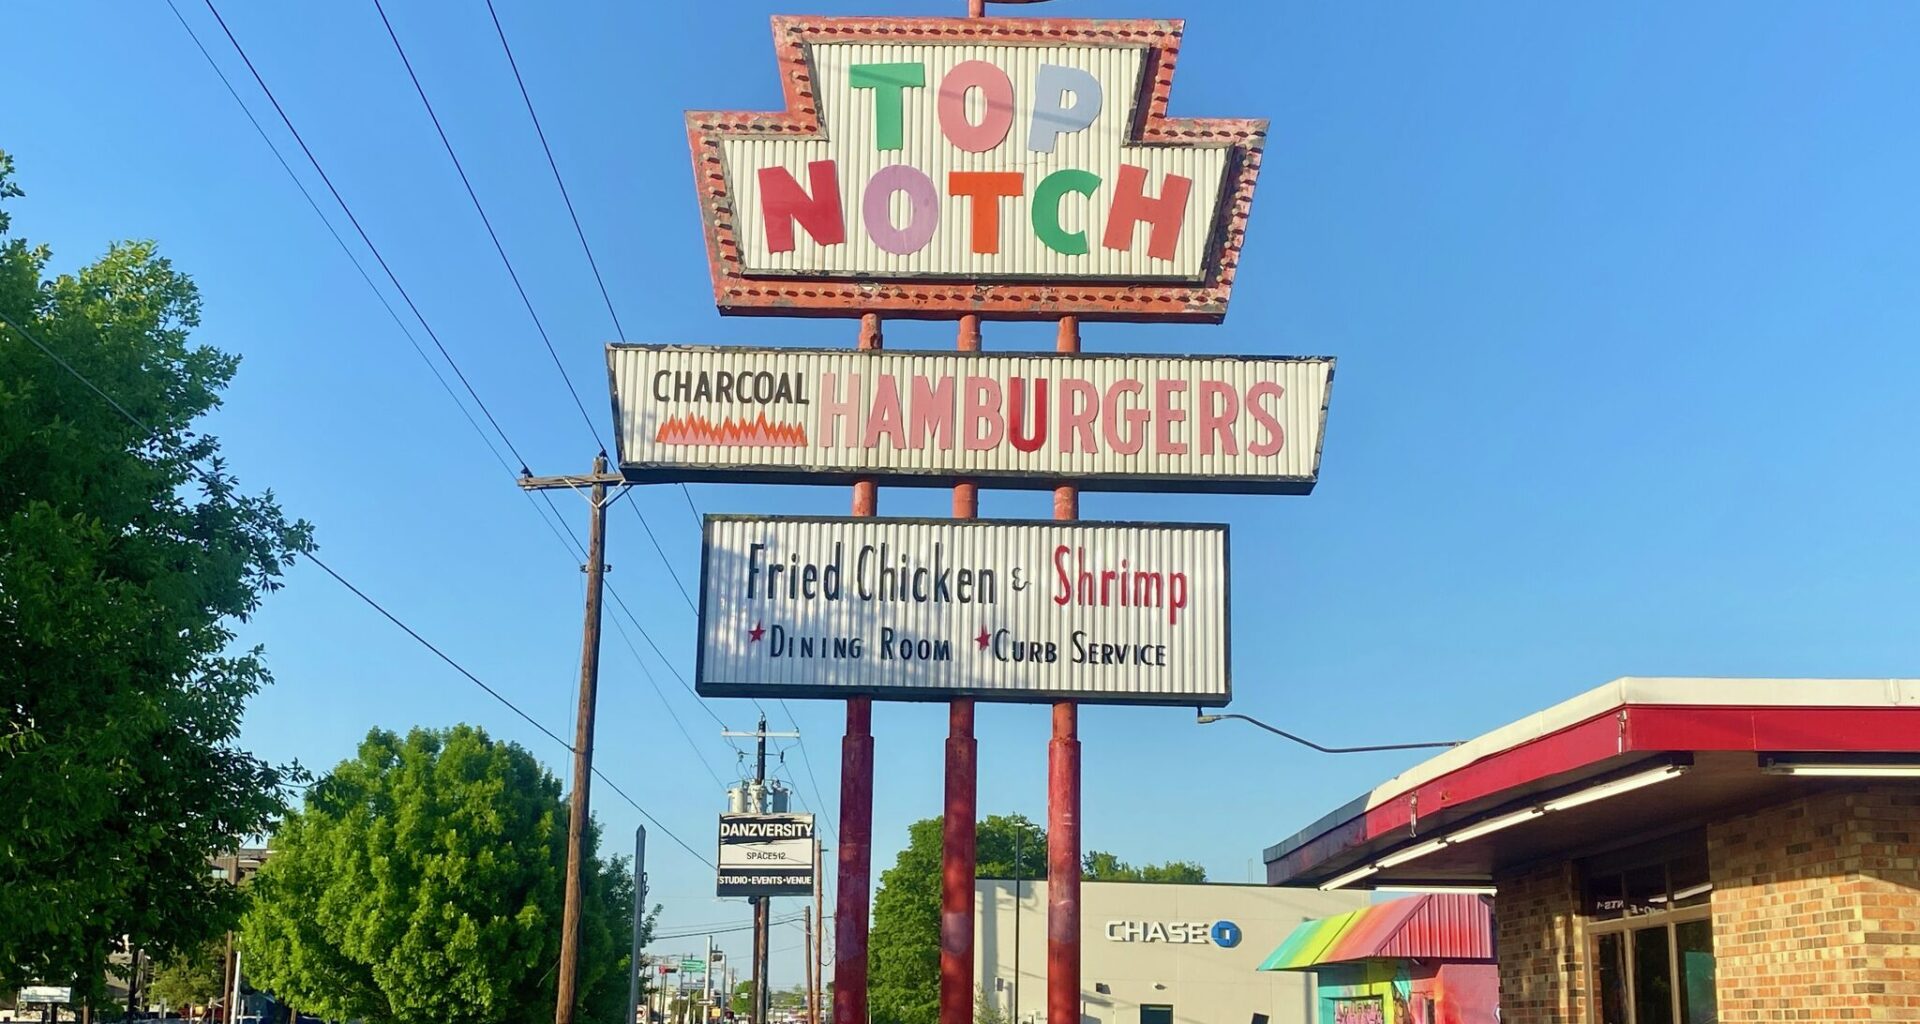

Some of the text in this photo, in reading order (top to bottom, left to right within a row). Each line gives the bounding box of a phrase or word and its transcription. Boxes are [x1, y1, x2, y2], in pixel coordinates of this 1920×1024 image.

[850, 60, 1103, 153] TOP
[758, 160, 1192, 262] NOTCH
[652, 370, 809, 405] CHARCOAL
[820, 372, 1285, 456] HAMBURGERS
[748, 541, 1188, 625] Fried Chicken & Shrimp
[770, 624, 952, 660] DINING ROOM
[994, 628, 1167, 667] CURB SERVICE
[720, 823, 813, 837] DANZVERSITY
[746, 852, 786, 860] SPACE512
[1105, 920, 1209, 944] CHASE
